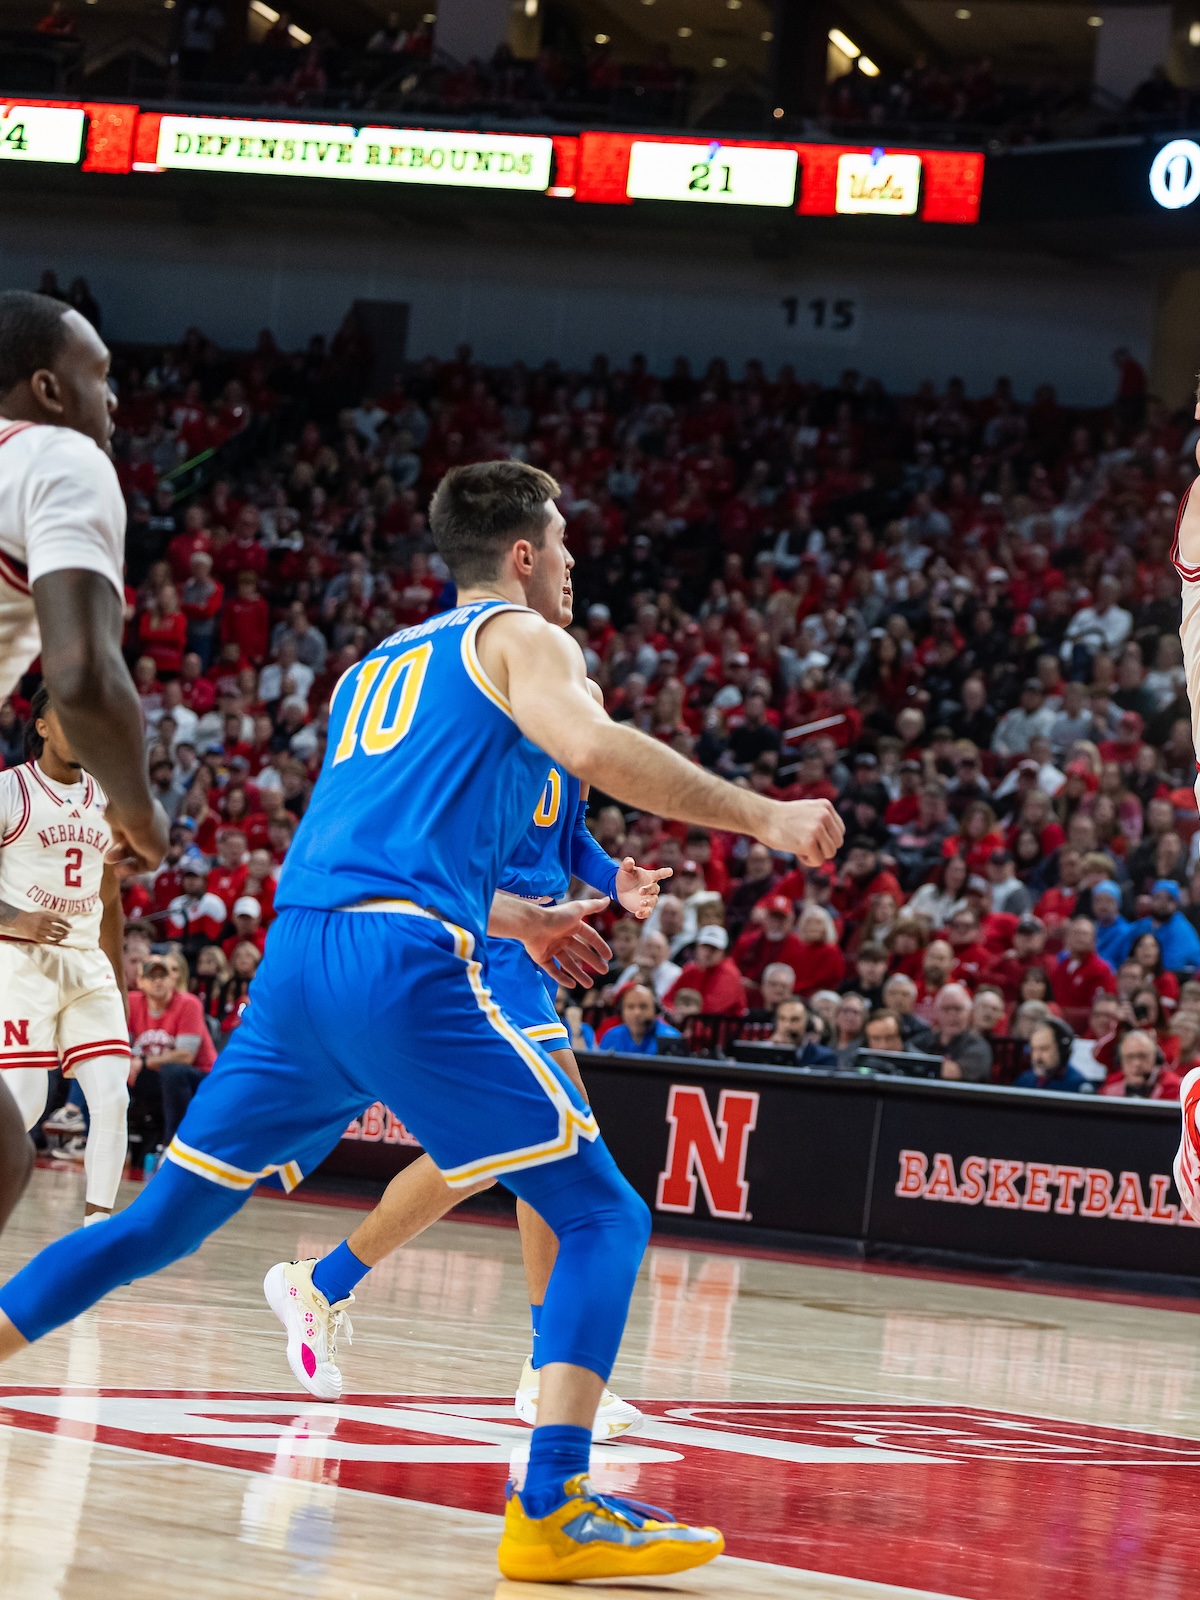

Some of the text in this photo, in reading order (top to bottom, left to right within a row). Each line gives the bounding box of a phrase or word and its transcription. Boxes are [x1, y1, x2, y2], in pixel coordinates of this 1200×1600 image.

[174, 132, 534, 176] DEFENSIVE REBOUNDS
[688, 162, 734, 193] 21
[781, 297, 854, 331] 115
[332, 640, 433, 768] 10
[37, 824, 110, 854] NEBRASKA
[65, 847, 83, 888] 2
[4, 1019, 30, 1047] N
[655, 1083, 760, 1221] N
